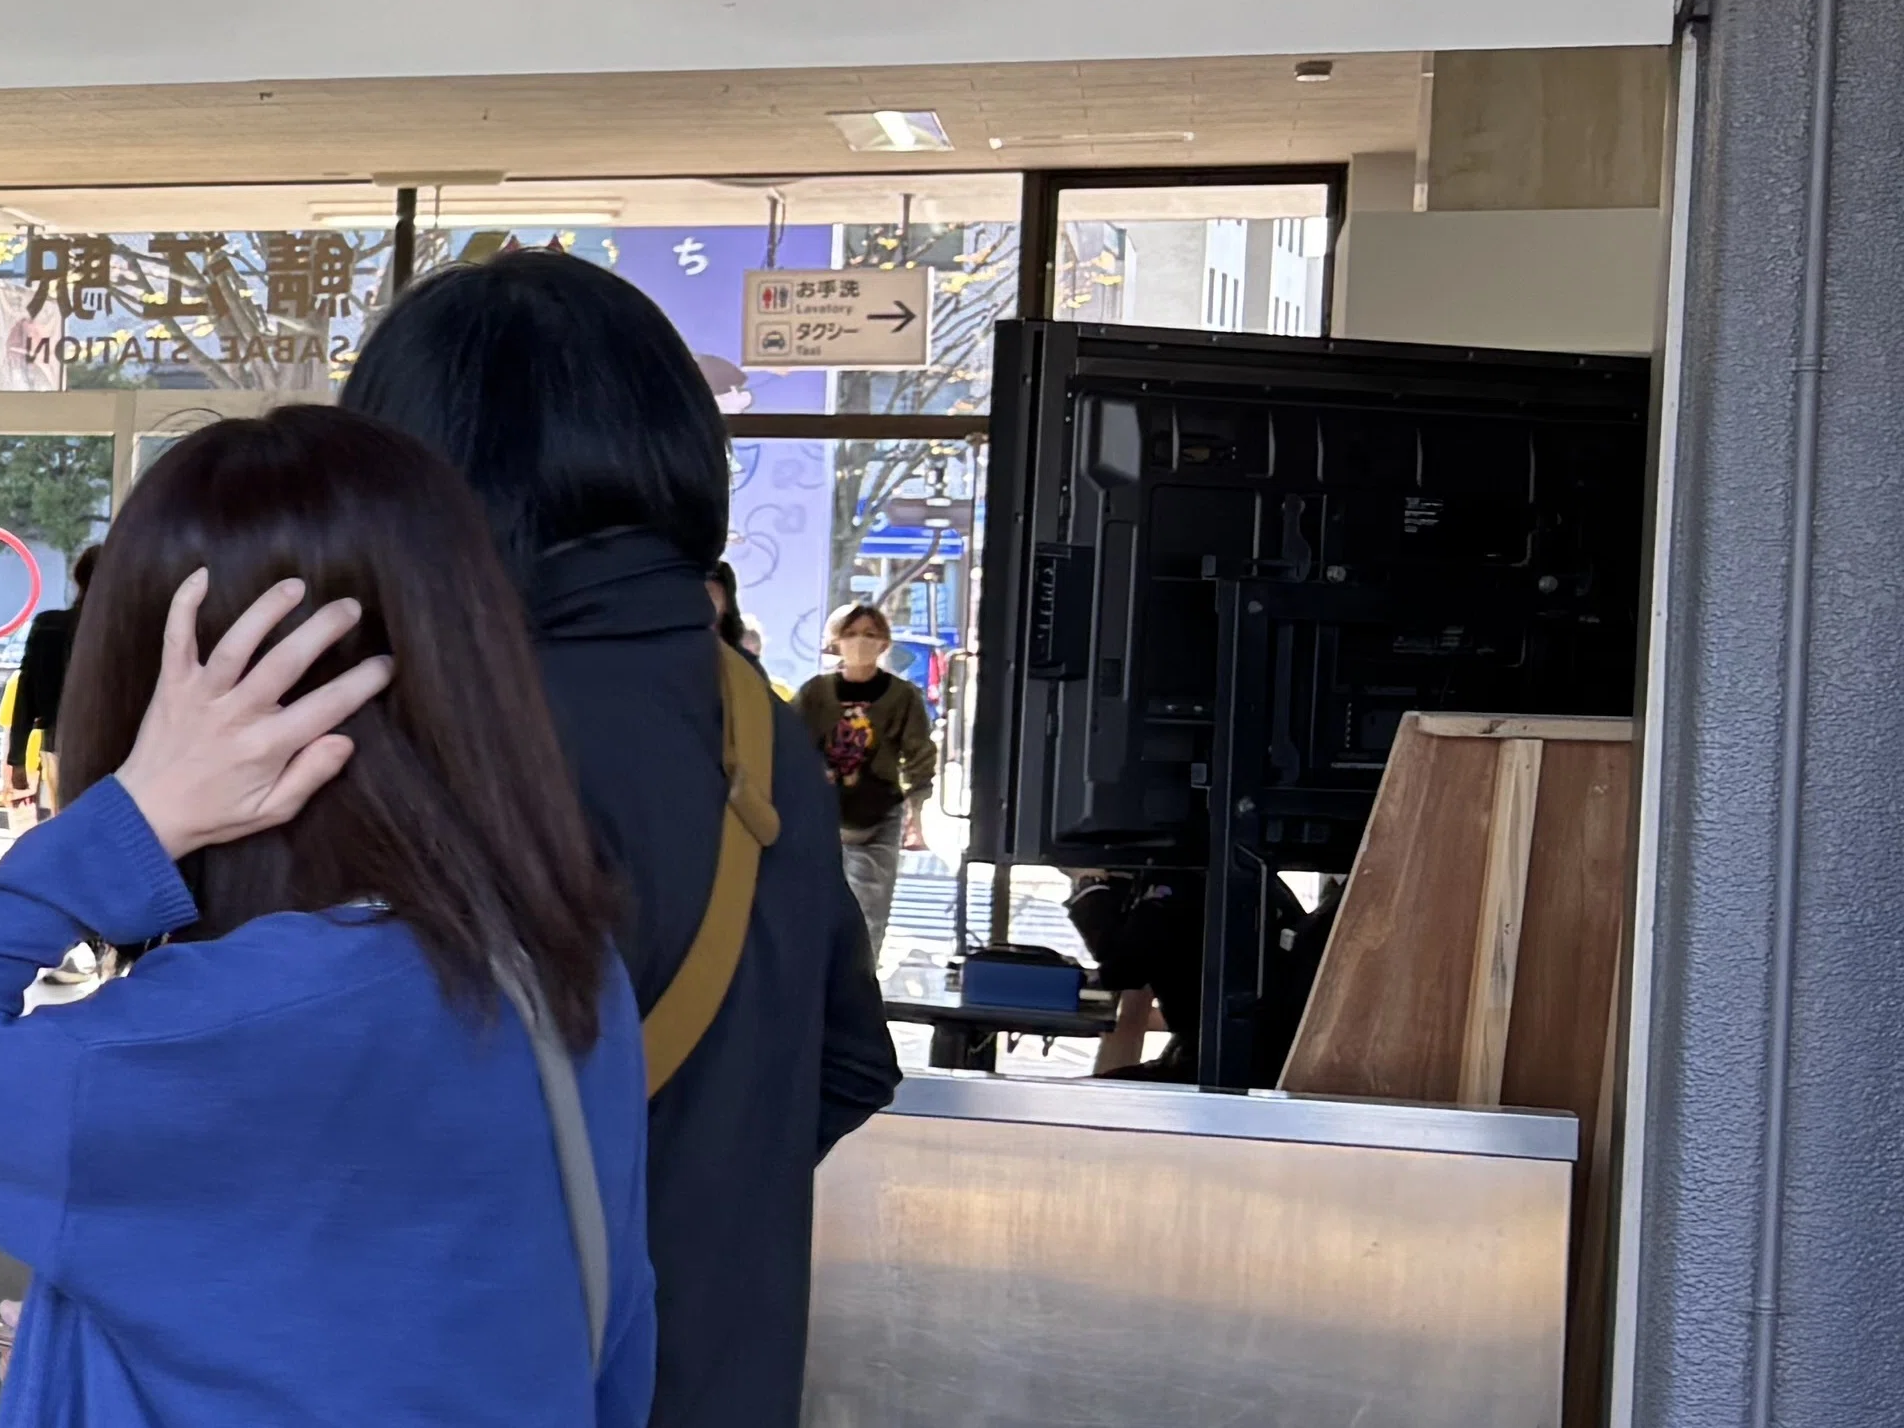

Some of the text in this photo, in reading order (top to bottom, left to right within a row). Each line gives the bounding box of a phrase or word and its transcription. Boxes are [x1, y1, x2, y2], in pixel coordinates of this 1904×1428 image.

[672, 236, 709, 276] ち
[795, 280, 860, 299] お手洗
[796, 303, 854, 316] Lavatory
[795, 323, 860, 341] タクシー
[796, 345, 821, 356] Taxi
